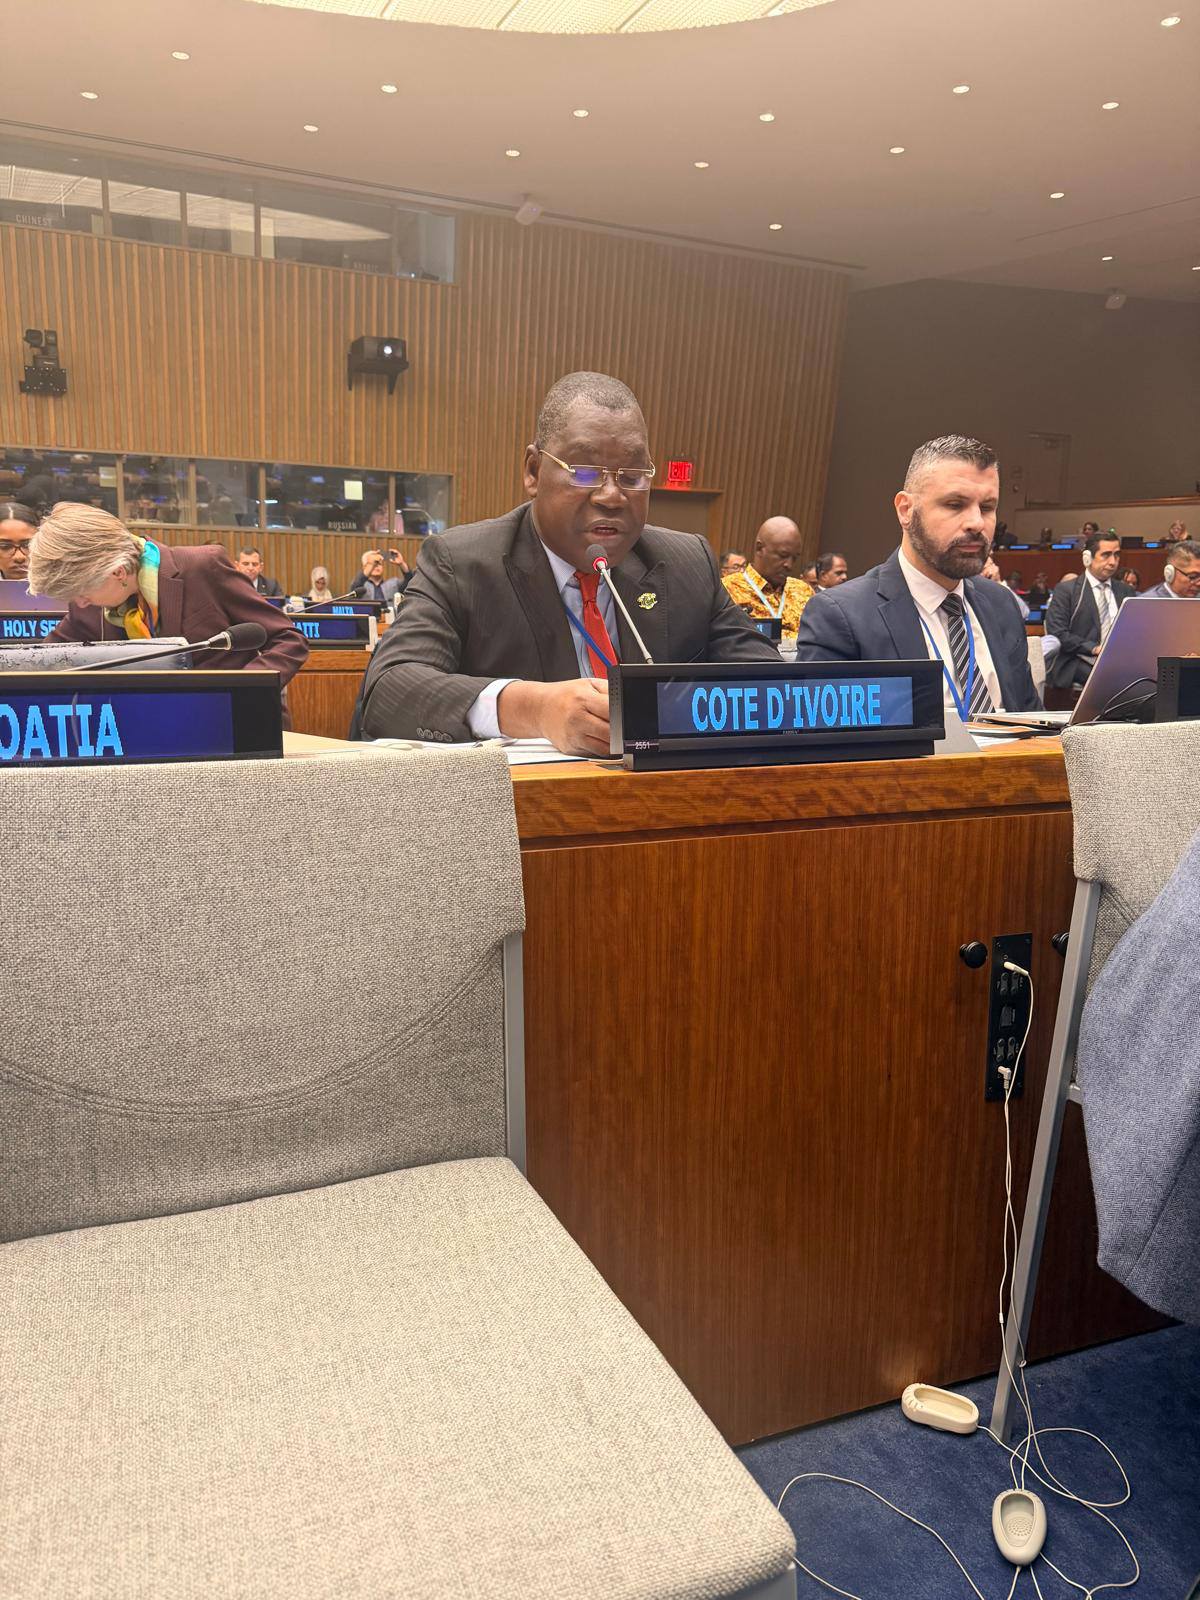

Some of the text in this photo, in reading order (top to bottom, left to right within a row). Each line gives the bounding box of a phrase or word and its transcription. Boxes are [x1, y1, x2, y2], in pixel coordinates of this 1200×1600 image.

[328, 520, 358, 530] RUSSIAN
[332, 606, 354, 616] MALTA
[3, 619, 38, 638] HOLY
[293, 621, 320, 638] AITI
[691, 683, 882, 731] COTE D'IVOIRE
[635, 741, 650, 750] 2551
